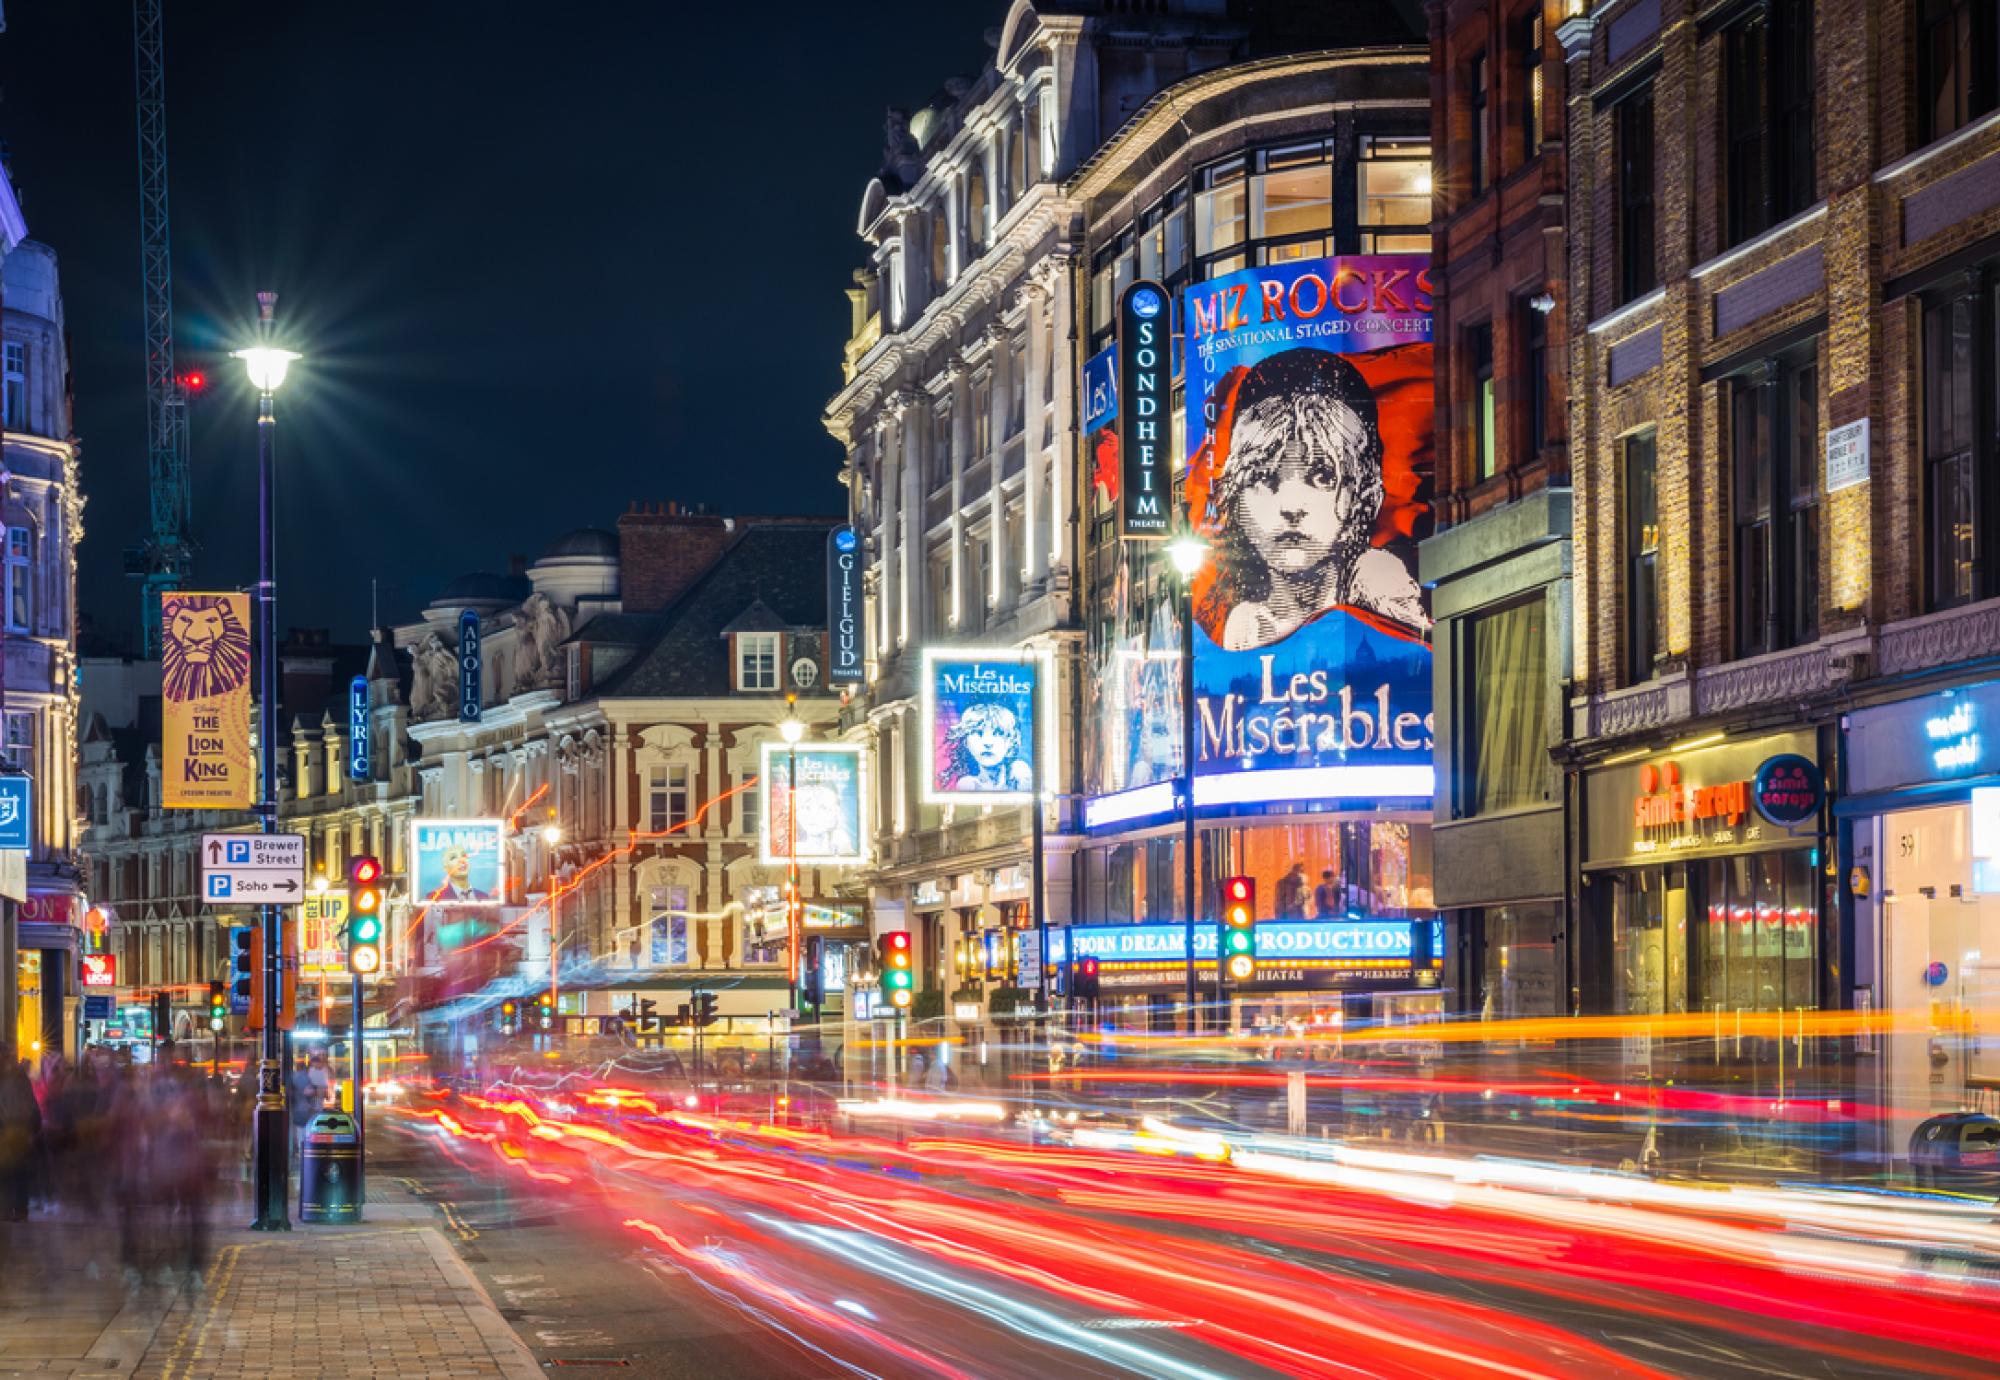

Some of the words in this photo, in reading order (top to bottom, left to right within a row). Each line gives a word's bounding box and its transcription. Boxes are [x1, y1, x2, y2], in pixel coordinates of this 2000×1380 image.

[1193, 284, 1249, 340] MIZ
[1215, 327, 1294, 353] SENSATIONAL
[1296, 320, 1350, 340] STAGED
[1354, 317, 1433, 334] CONCERT
[1085, 368, 1107, 422] Les
[1137, 322, 1160, 515] SONDHEIM
[1128, 518, 1167, 529] THEATRE
[838, 554, 856, 666] GIELGUD
[463, 624, 479, 718] APOLLO
[973, 664, 997, 680] Les
[1259, 653, 1328, 705] Les
[192, 716, 220, 729] THE
[353, 691, 369, 772] LYRIC
[253, 839, 299, 850] Brewer
[256, 852, 297, 864] Street
[237, 880, 268, 892] Soho
[1121, 932, 1186, 952] DREAM
[1255, 927, 1413, 950] RODUCTION
